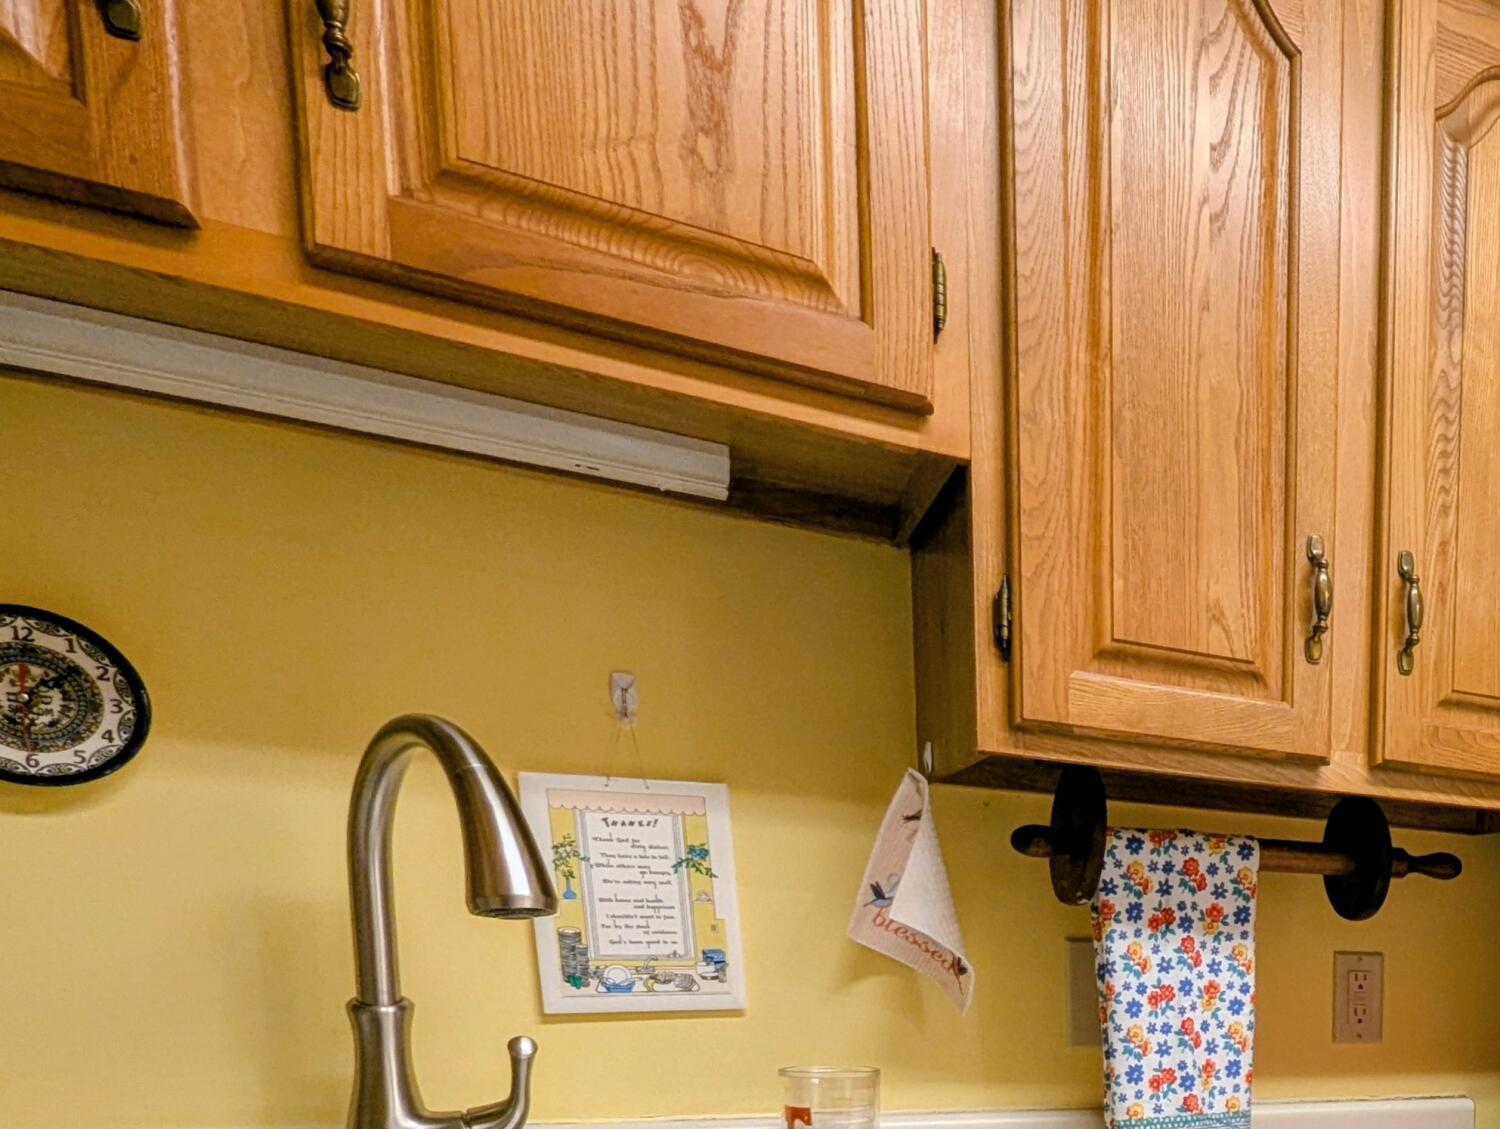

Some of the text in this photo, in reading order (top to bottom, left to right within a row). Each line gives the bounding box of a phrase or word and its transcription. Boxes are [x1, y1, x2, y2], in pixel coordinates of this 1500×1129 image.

[10, 625, 35, 642] 12
[64, 637, 77, 654] 1
[96, 665, 111, 682] 2
[110, 698, 124, 714] 3
[101, 729, 115, 744] 4
[25, 753, 40, 769] 6
[73, 750, 87, 765] 5
